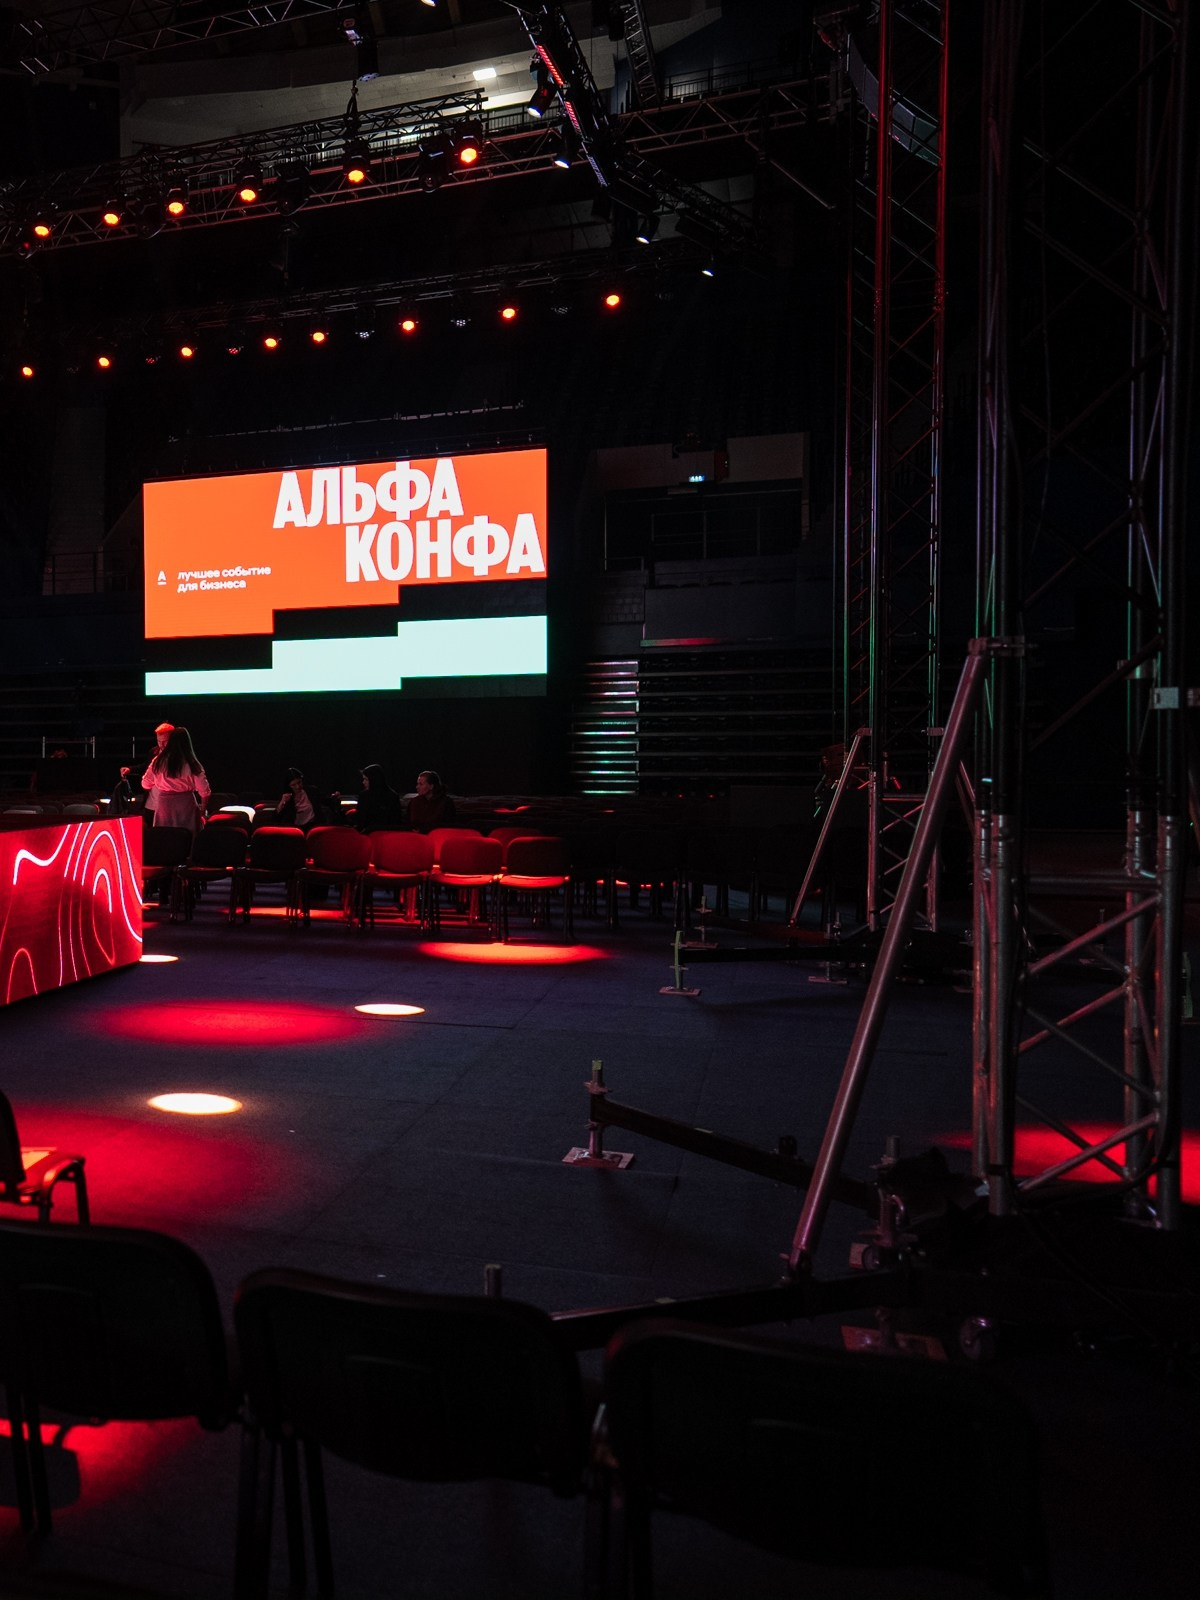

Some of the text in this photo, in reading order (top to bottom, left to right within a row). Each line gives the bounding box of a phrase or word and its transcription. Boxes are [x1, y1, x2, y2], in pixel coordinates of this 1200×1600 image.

[273, 458, 464, 528] АЛЬФА
[346, 513, 545, 582] КОНФА
[177, 566, 271, 581] лучшее событие
[177, 580, 246, 593] для бизнеса
